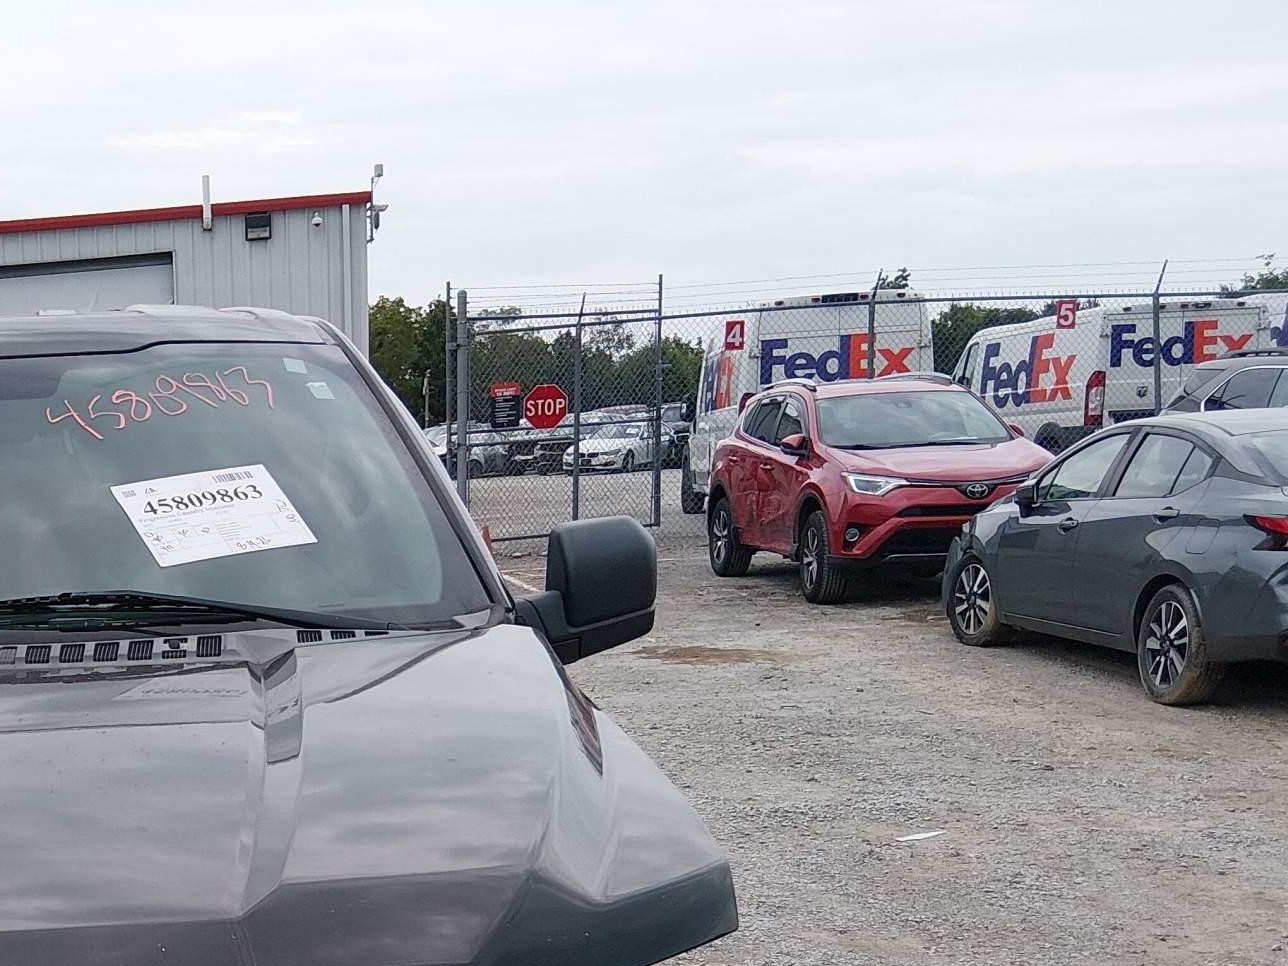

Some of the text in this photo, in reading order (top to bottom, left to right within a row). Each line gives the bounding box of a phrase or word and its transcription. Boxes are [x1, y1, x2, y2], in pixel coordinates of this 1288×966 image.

[1058, 303, 1075, 326] 5
[726, 323, 743, 347] 4
[1110, 320, 1254, 368] FedEx
[760, 333, 915, 385] FedEx
[980, 332, 1077, 409] FedEx
[44, 366, 275, 440] 45809863
[526, 398, 565, 417] STOP
[143, 484, 263, 515] 45809863
